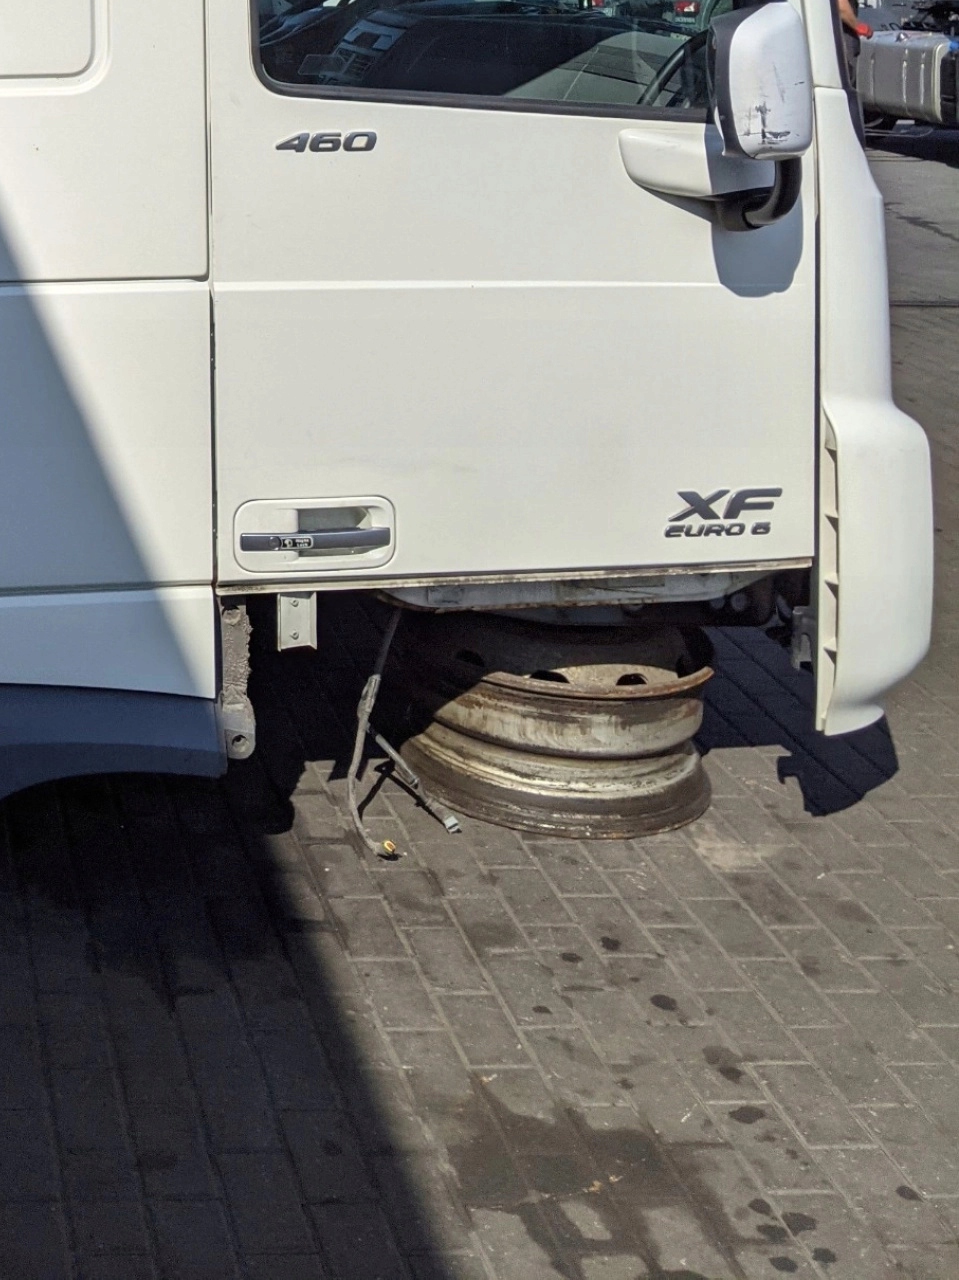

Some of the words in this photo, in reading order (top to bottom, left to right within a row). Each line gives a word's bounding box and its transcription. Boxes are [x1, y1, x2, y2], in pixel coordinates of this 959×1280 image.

[275, 131, 377, 153] 460
[667, 487, 783, 522] XF
[664, 523, 746, 538] EURO
[751, 522, 771, 535] 6
